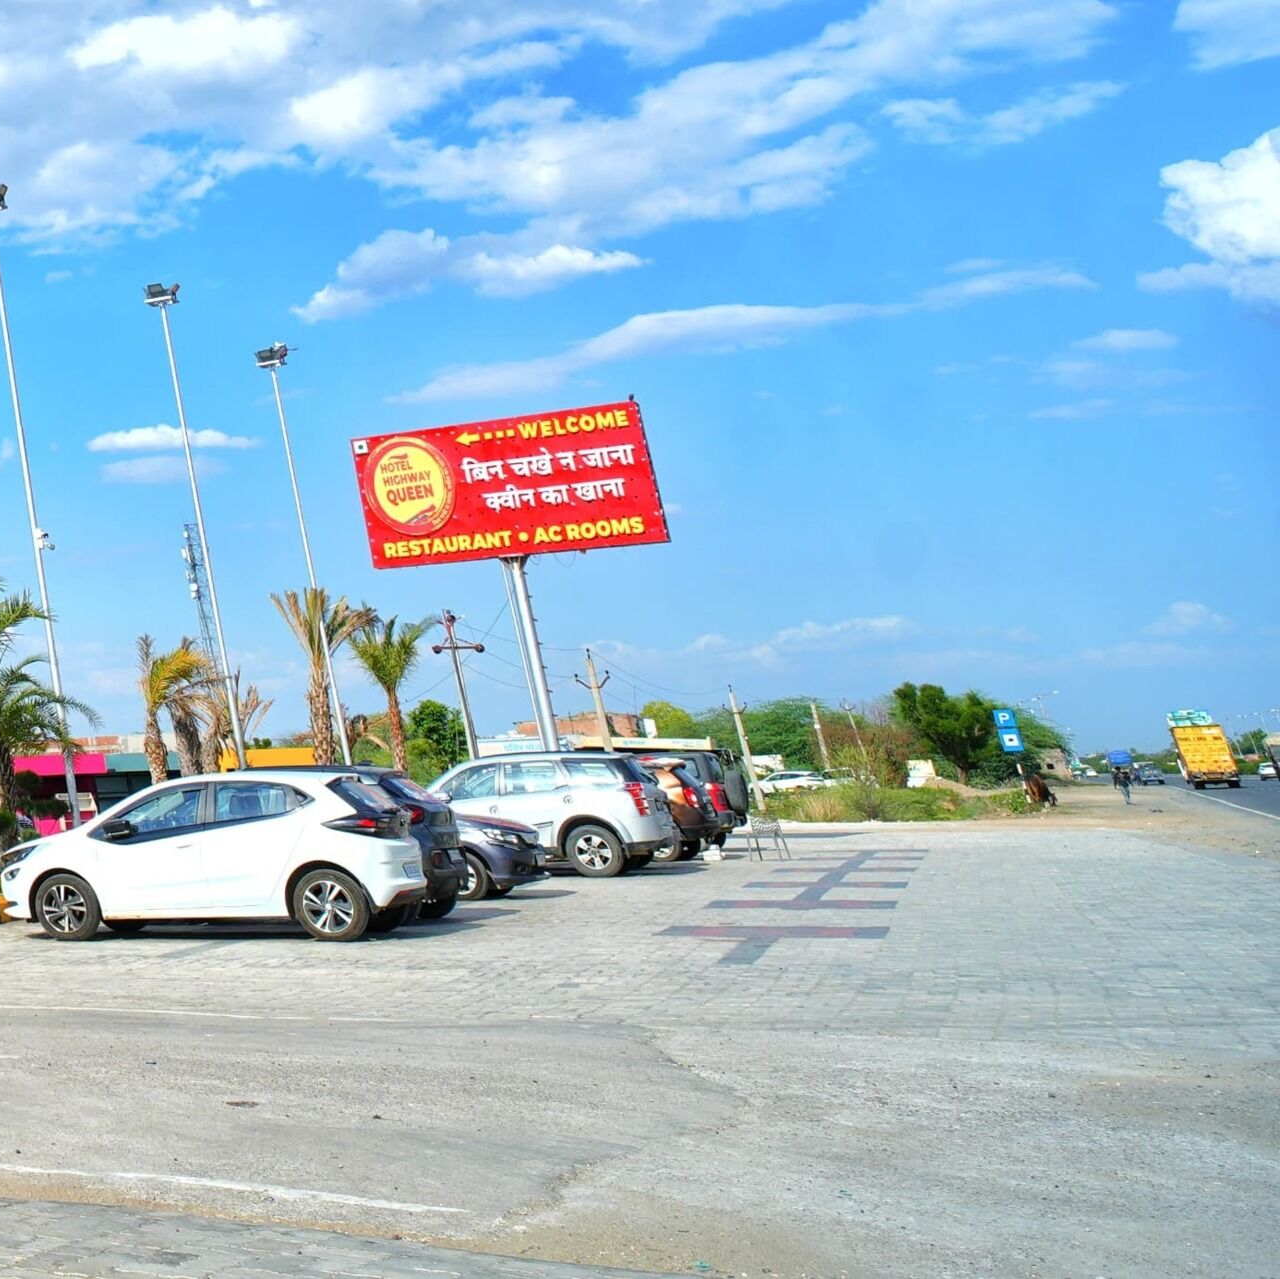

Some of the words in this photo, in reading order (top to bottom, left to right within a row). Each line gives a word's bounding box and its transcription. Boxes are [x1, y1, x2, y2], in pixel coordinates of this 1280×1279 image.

[518, 410, 630, 440] WELCOME
[380, 458, 413, 474] HOTEL
[461, 457, 505, 484] बिन
[508, 448, 554, 478] चखे
[555, 451, 577, 472] न
[577, 444, 636, 467] जाना
[382, 470, 432, 487] HIGHWAY
[385, 483, 435, 506] QUEEN
[482, 484, 535, 513] क्वीन
[537, 484, 571, 505] का
[572, 478, 626, 501] खाना
[383, 530, 513, 559] RESTAURANT
[533, 525, 562, 545] AC
[567, 516, 645, 541] ROOMS
[998, 712, 1010, 725] P
